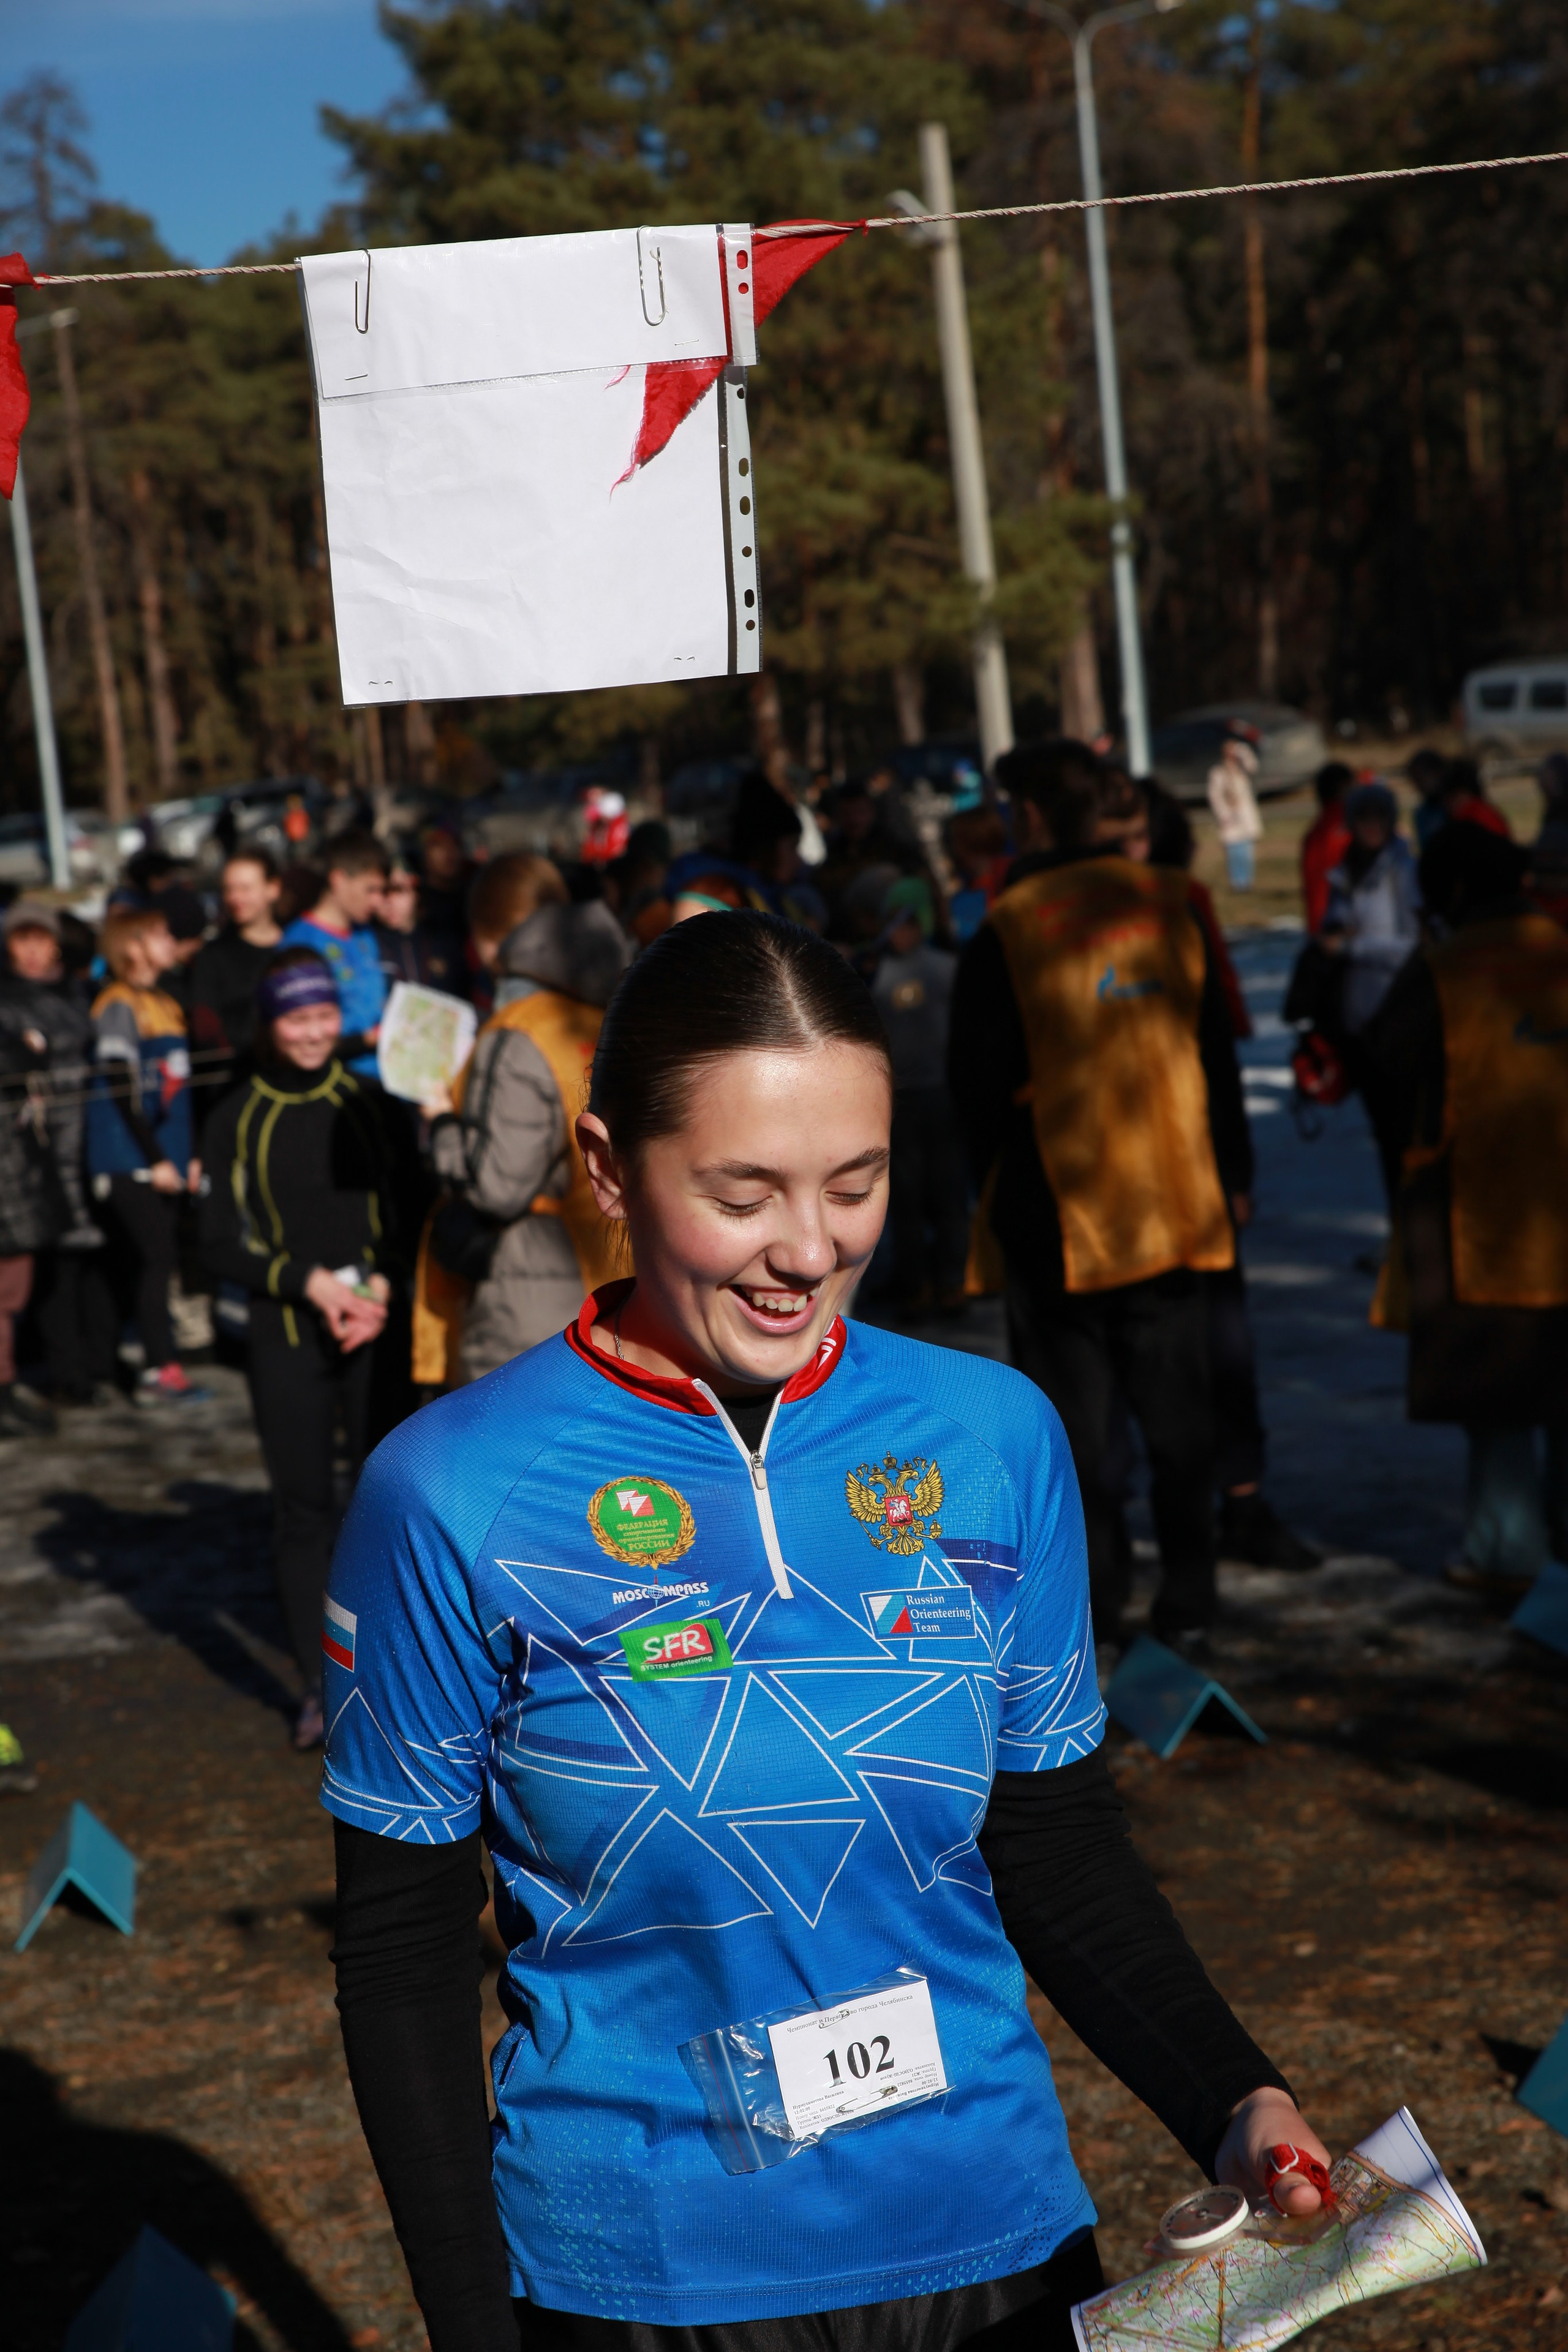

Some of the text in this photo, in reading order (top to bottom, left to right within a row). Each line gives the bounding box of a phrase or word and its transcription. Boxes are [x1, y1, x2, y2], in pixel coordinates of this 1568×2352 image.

[616, 1518, 668, 1531] ФЕДЕРАЦИЯ
[627, 1540, 671, 1550] РОССИИ
[906, 1594, 945, 1605] Russian
[910, 1607, 971, 1620] Orienteering
[913, 1623, 940, 1632] Team
[644, 1630, 706, 1661] SFR
[641, 1656, 712, 1672] SYSTEM orienteering
[787, 2020, 818, 2033] Чемпионат
[824, 2009, 857, 2022] Первево
[859, 2003, 878, 2013] города
[879, 1994, 913, 2007] Челябинска
[823, 2035, 894, 2089] 102
